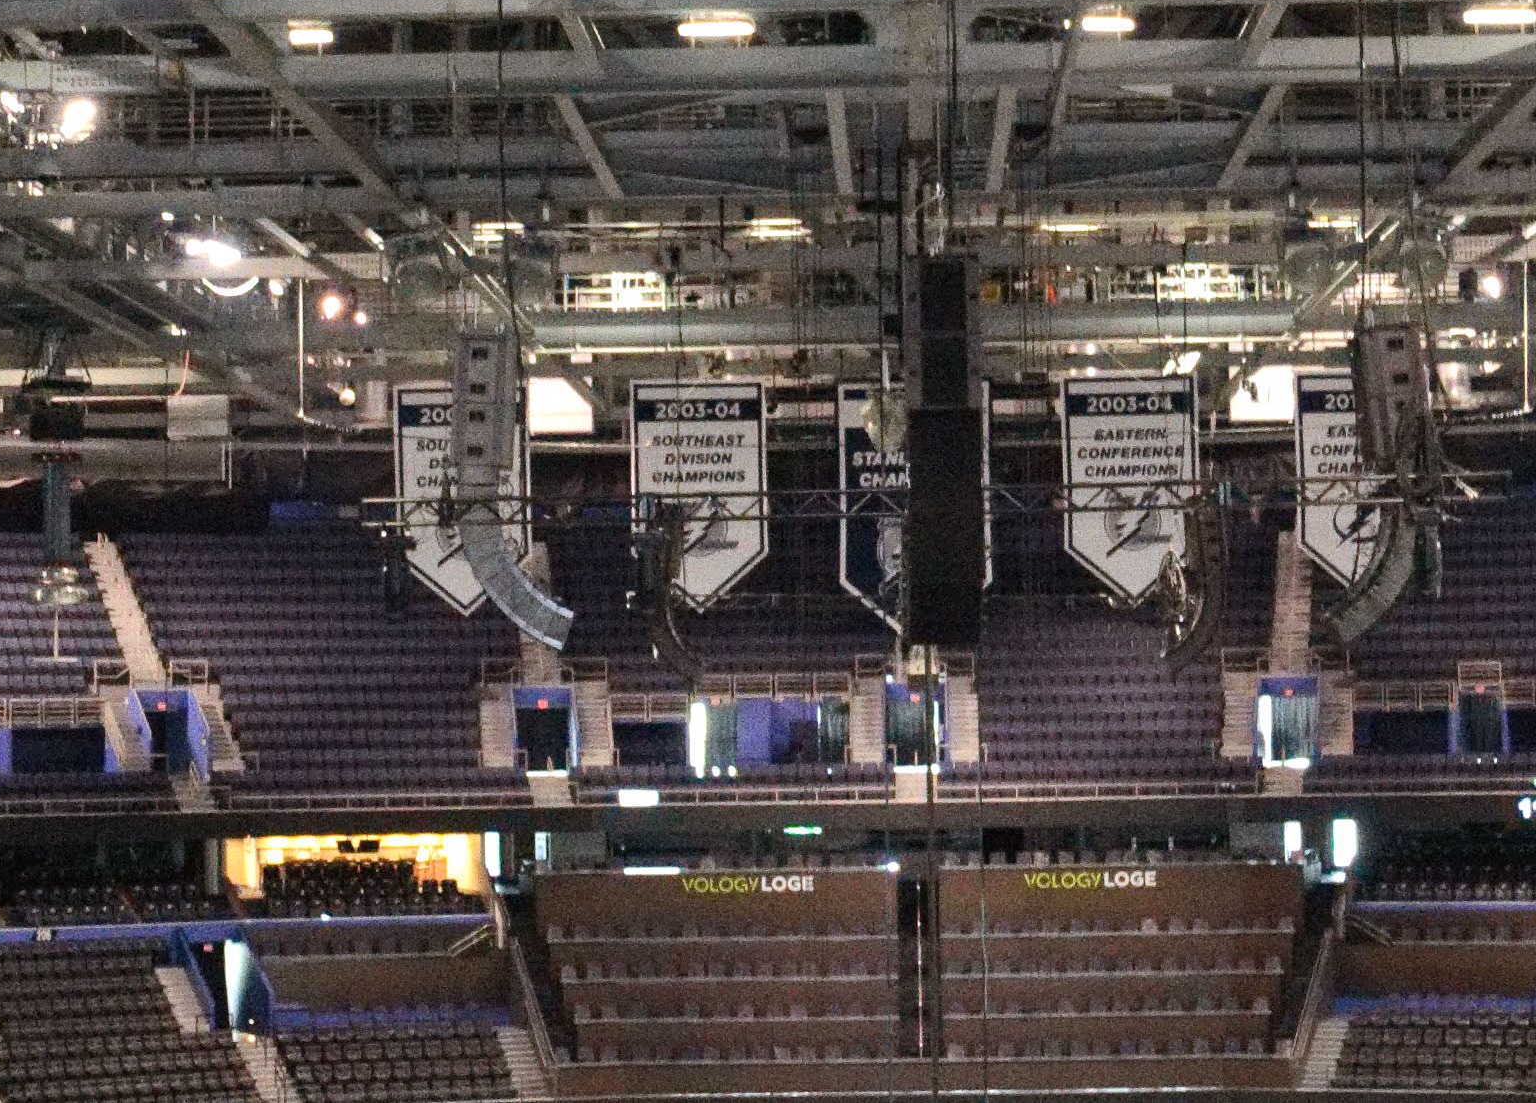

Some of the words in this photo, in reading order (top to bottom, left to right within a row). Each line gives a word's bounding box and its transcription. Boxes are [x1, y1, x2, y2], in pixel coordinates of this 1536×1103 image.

[655, 402, 740, 419] 2003-04
[1086, 396, 1172, 413] 2003-04
[653, 434, 745, 447] SOUTHEAST
[1094, 428, 1167, 441] EASTERN
[1077, 446, 1185, 460] CONFERENCE
[652, 470, 746, 483] CHAMPIONS
[1085, 464, 1179, 477] CHAMPIONS
